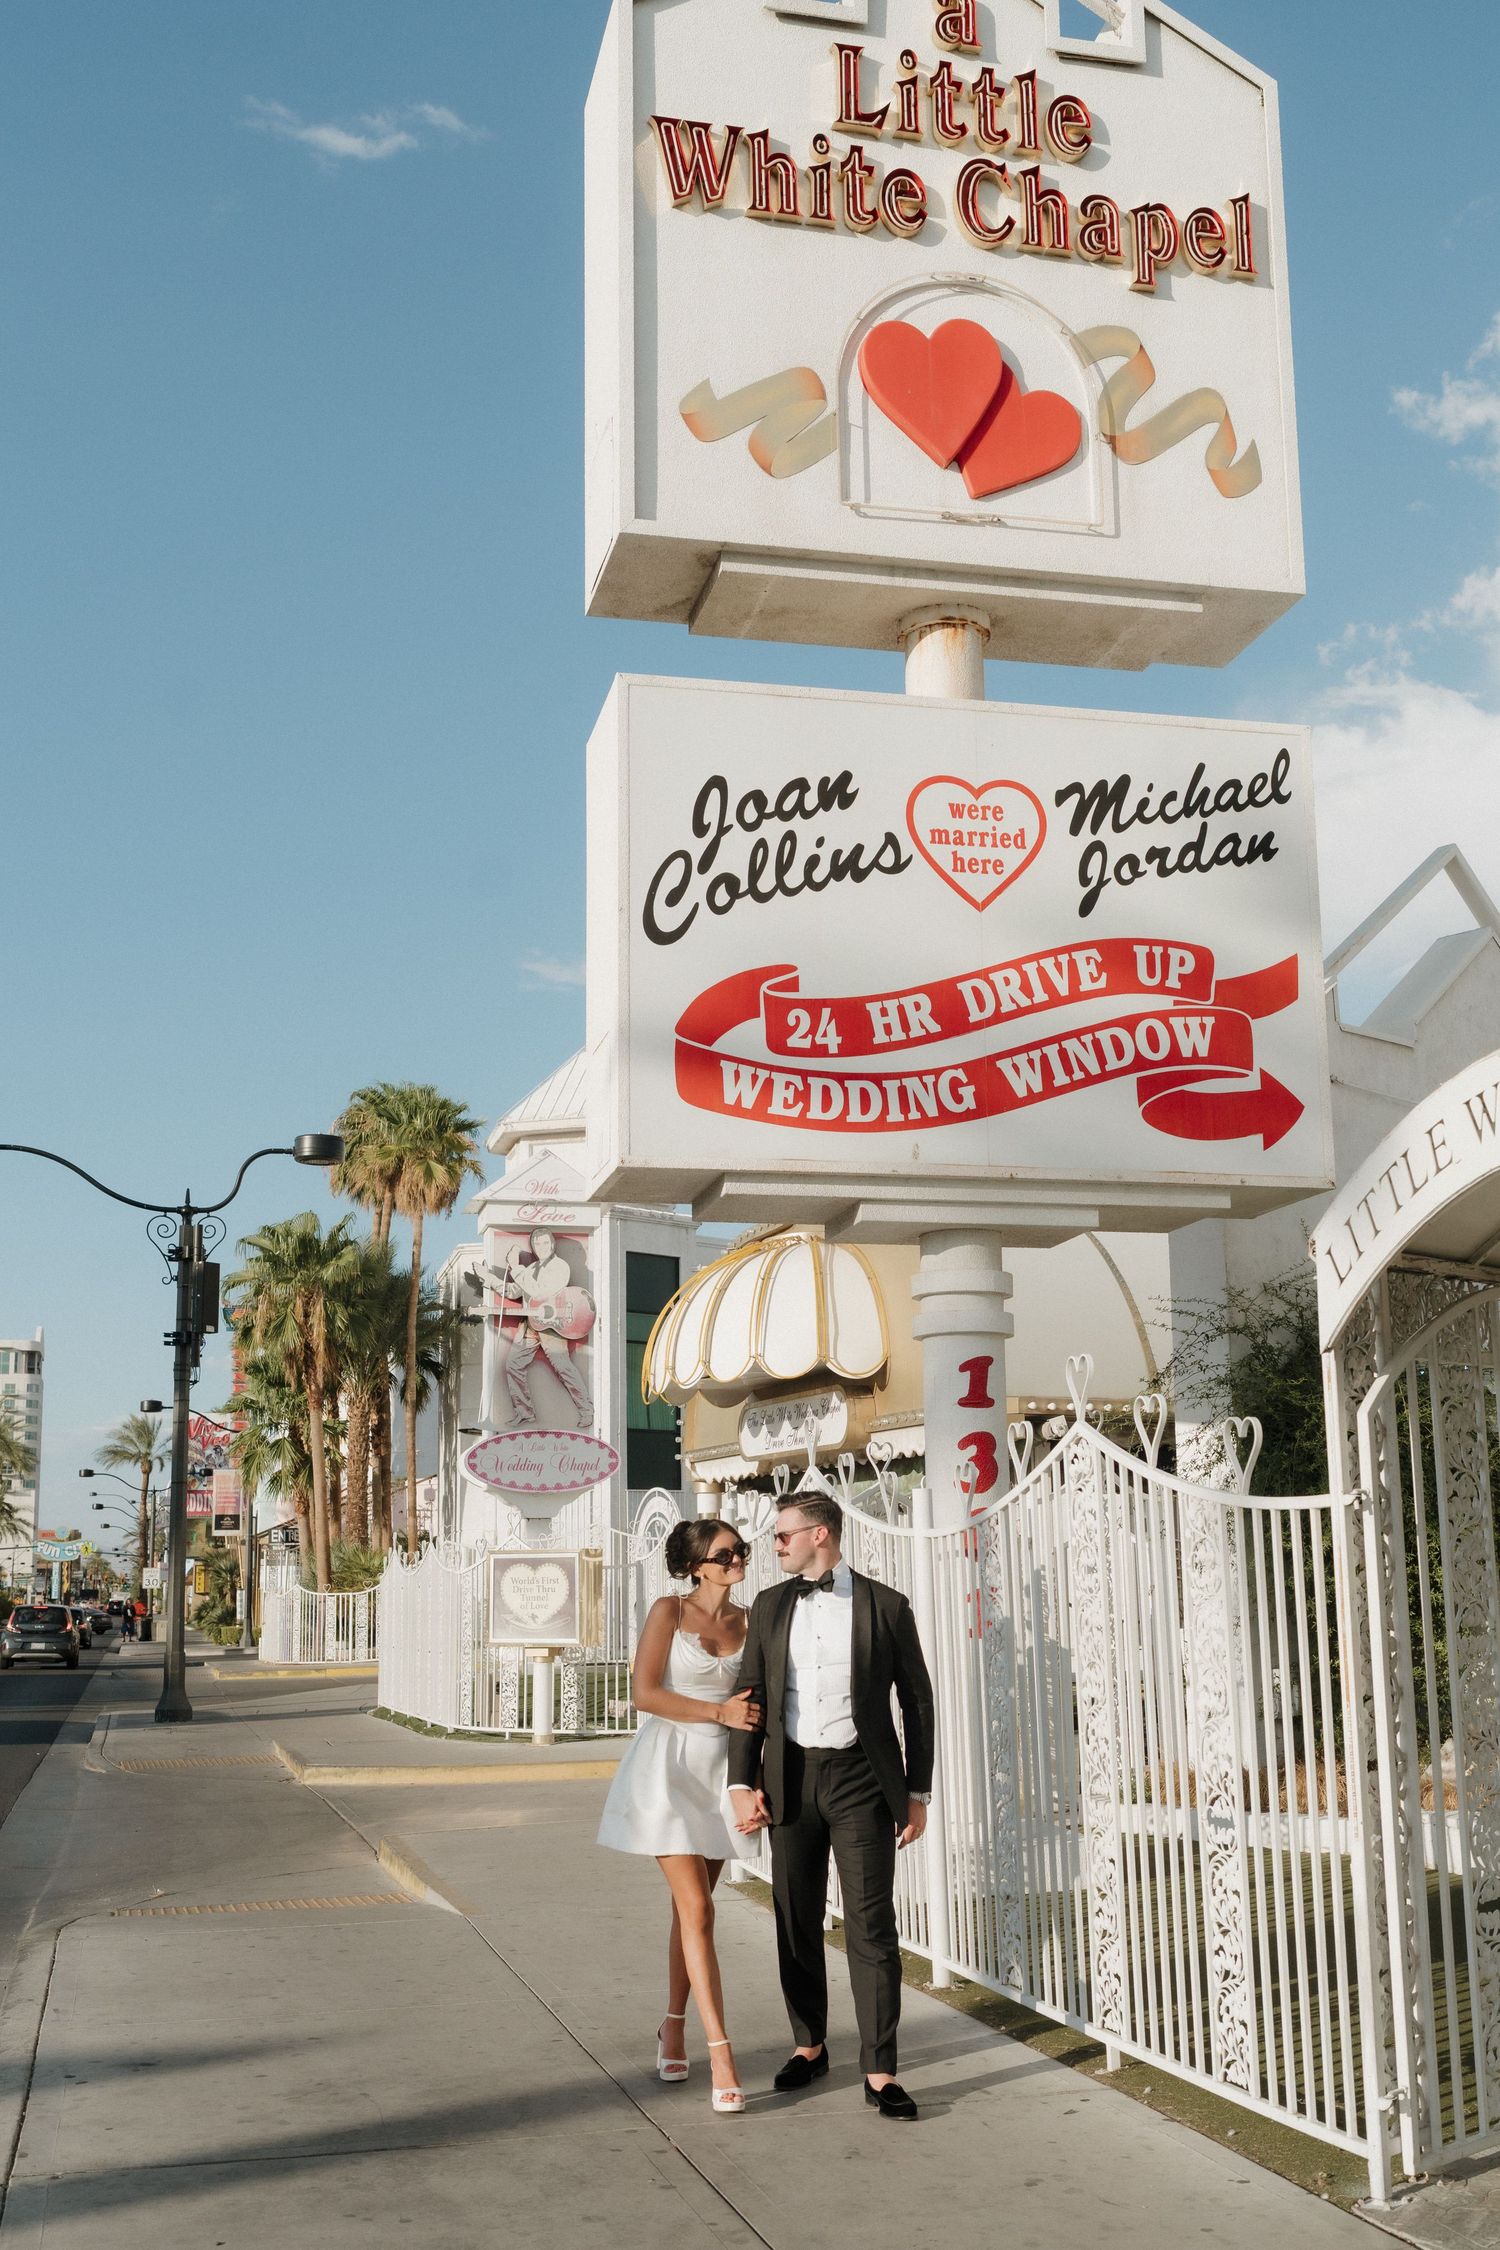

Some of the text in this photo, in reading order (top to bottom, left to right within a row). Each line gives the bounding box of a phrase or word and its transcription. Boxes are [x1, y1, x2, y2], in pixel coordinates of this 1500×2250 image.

[832, 43, 1093, 162] Little
[650, 115, 1260, 292] White Chapel
[1054, 747, 1292, 837] Michael
[692, 769, 860, 875] Joan
[948, 802, 1004, 822] were
[929, 825, 1027, 850] married
[951, 849, 1005, 876] here
[1078, 821, 1280, 919] Jordan
[642, 829, 913, 946] Collins
[786, 944, 1196, 1055] 24 HR DRIVE UP
[719, 1016, 1216, 1123] WEDDING WINDOW
[525, 1178, 561, 1196] With
[512, 1199, 577, 1224] Love
[1325, 1118, 1455, 1286] LITTLE
[480, 1452, 601, 1478] Wedding Chapel
[144, 1578, 159, 1587] 30
[510, 1576, 560, 1585] World's First
[512, 1585, 556, 1594] Drive Thru
[519, 1602, 549, 1610] of Love
[520, 1594, 549, 1602] Tunnel
